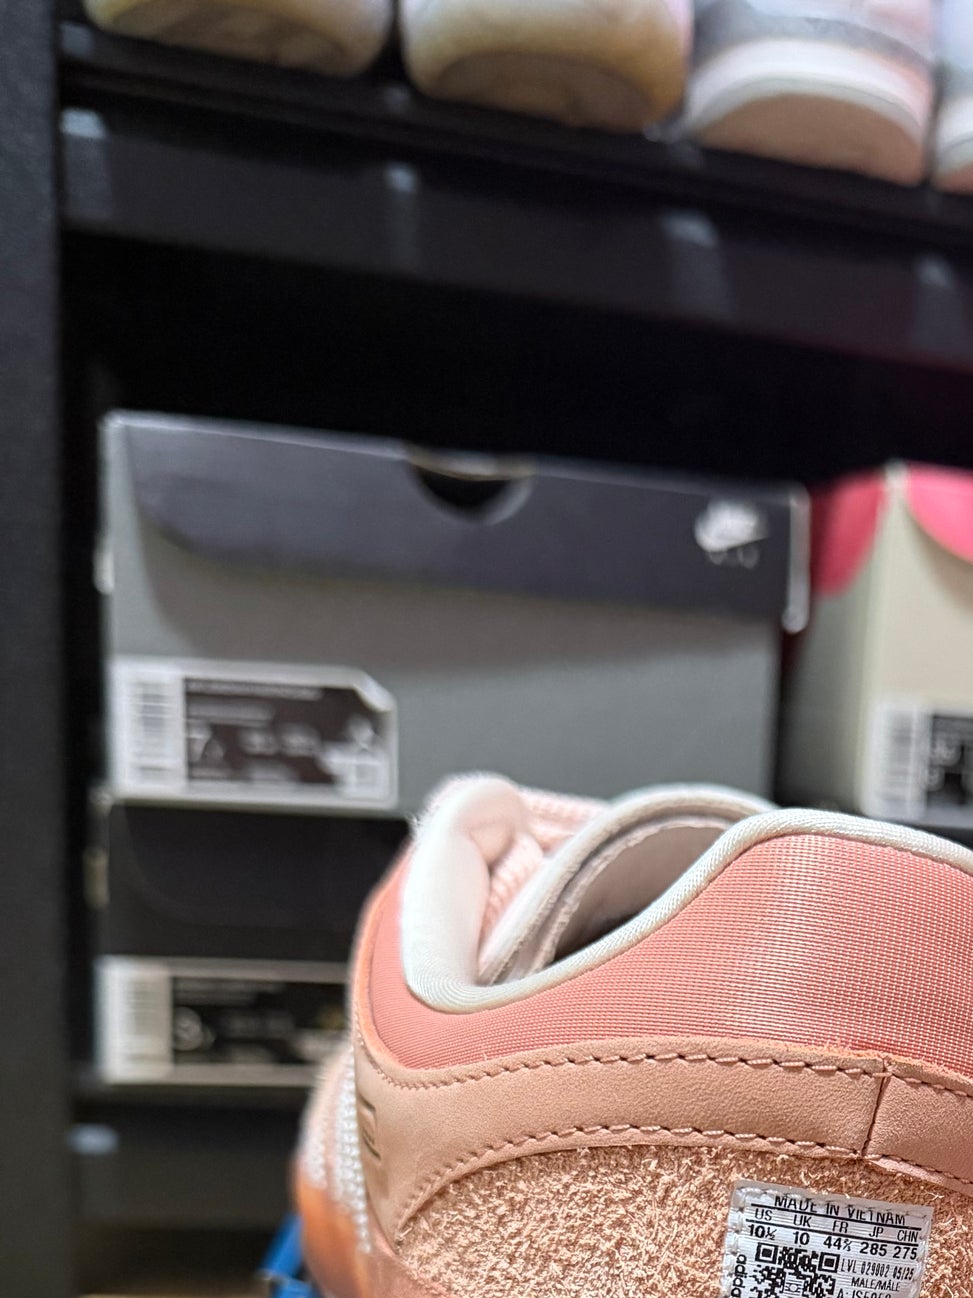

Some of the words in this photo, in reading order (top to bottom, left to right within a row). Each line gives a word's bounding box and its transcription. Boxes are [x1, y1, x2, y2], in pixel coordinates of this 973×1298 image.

[774, 1195, 818, 1213] MADE
[826, 1203, 838, 1216] IN
[847, 1205, 905, 1225] VIETNAM
[755, 1208, 773, 1221] US
[793, 1215, 812, 1227] UK
[832, 1220, 848, 1233] FR
[869, 1226, 884, 1238] JP
[897, 1229, 918, 1242] CHN
[793, 1231, 809, 1246] 10
[860, 1242, 887, 1257] 285
[893, 1246, 918, 1260] 275
[840, 1258, 857, 1274] LVL
